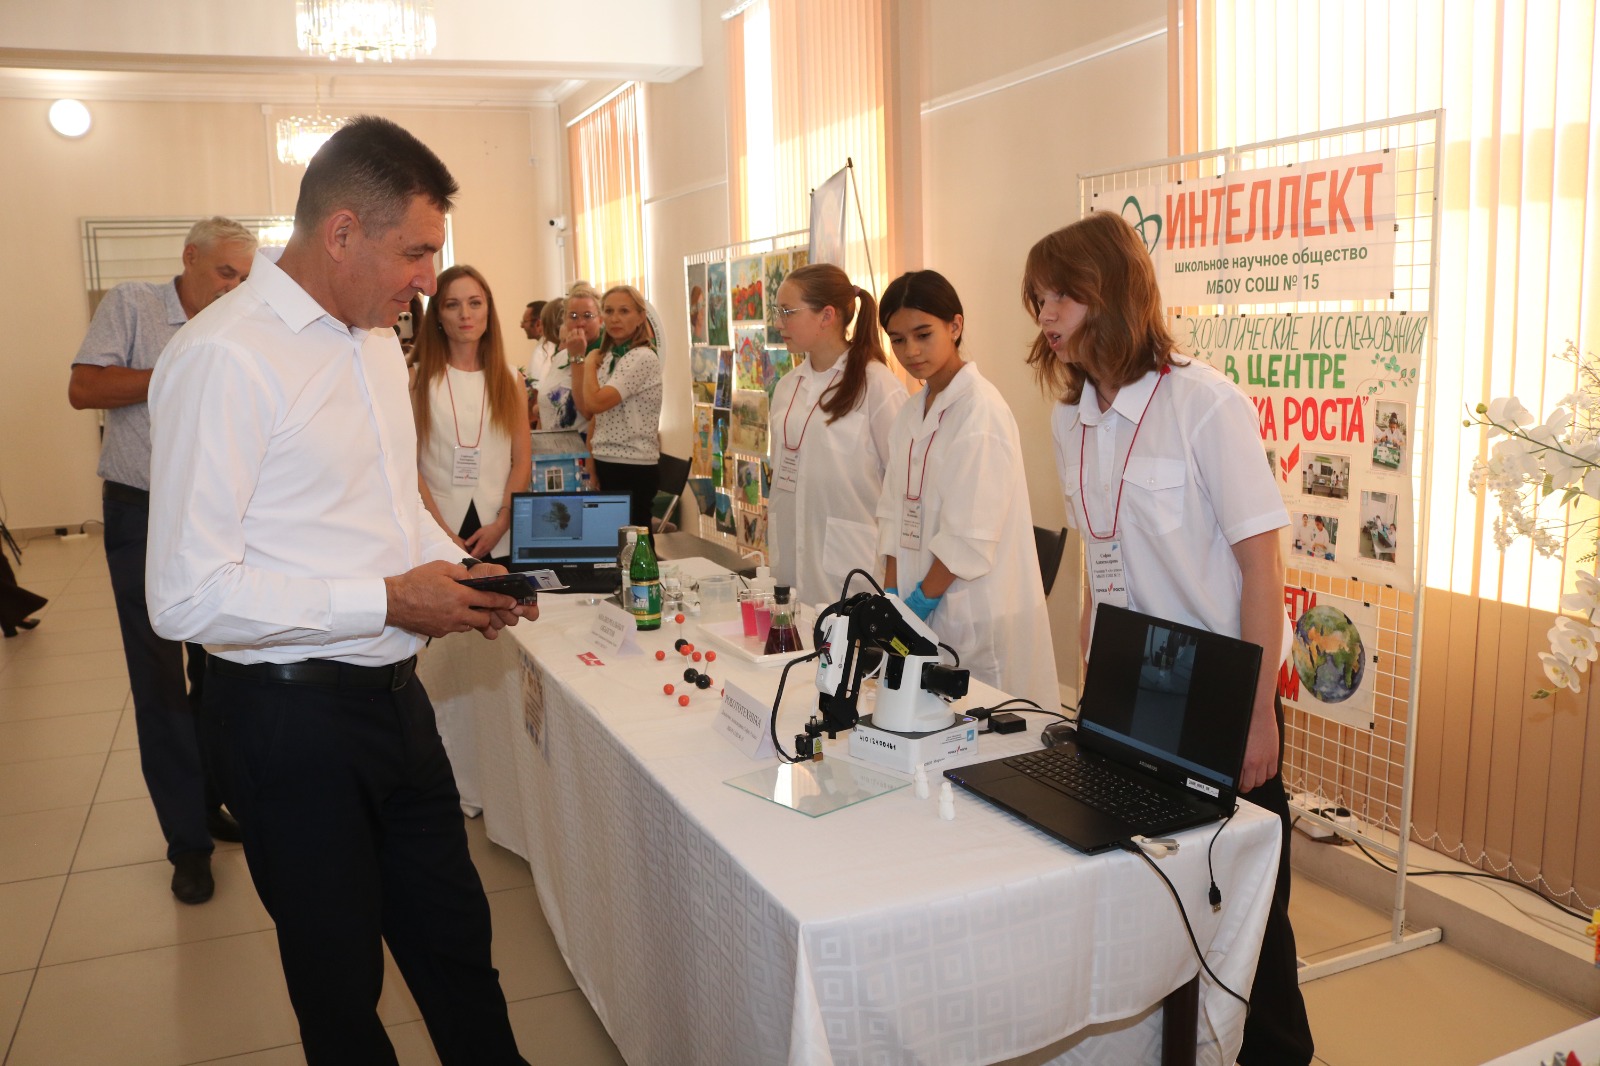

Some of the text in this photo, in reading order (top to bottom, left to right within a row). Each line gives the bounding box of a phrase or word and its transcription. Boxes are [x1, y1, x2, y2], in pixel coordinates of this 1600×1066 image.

[1166, 163, 1383, 250] ИНТЕЛЛЕКТ
[1174, 246, 1368, 273] школьное научное общество
[1206, 273, 1319, 295] МБОУ СОШ № 15
[1186, 315, 1428, 354] ЭКОЛОГИЧЕСКИЕ ИССЛЕДОВАНИЯ
[1225, 353, 1347, 389] В ЦЕНТРЕ
